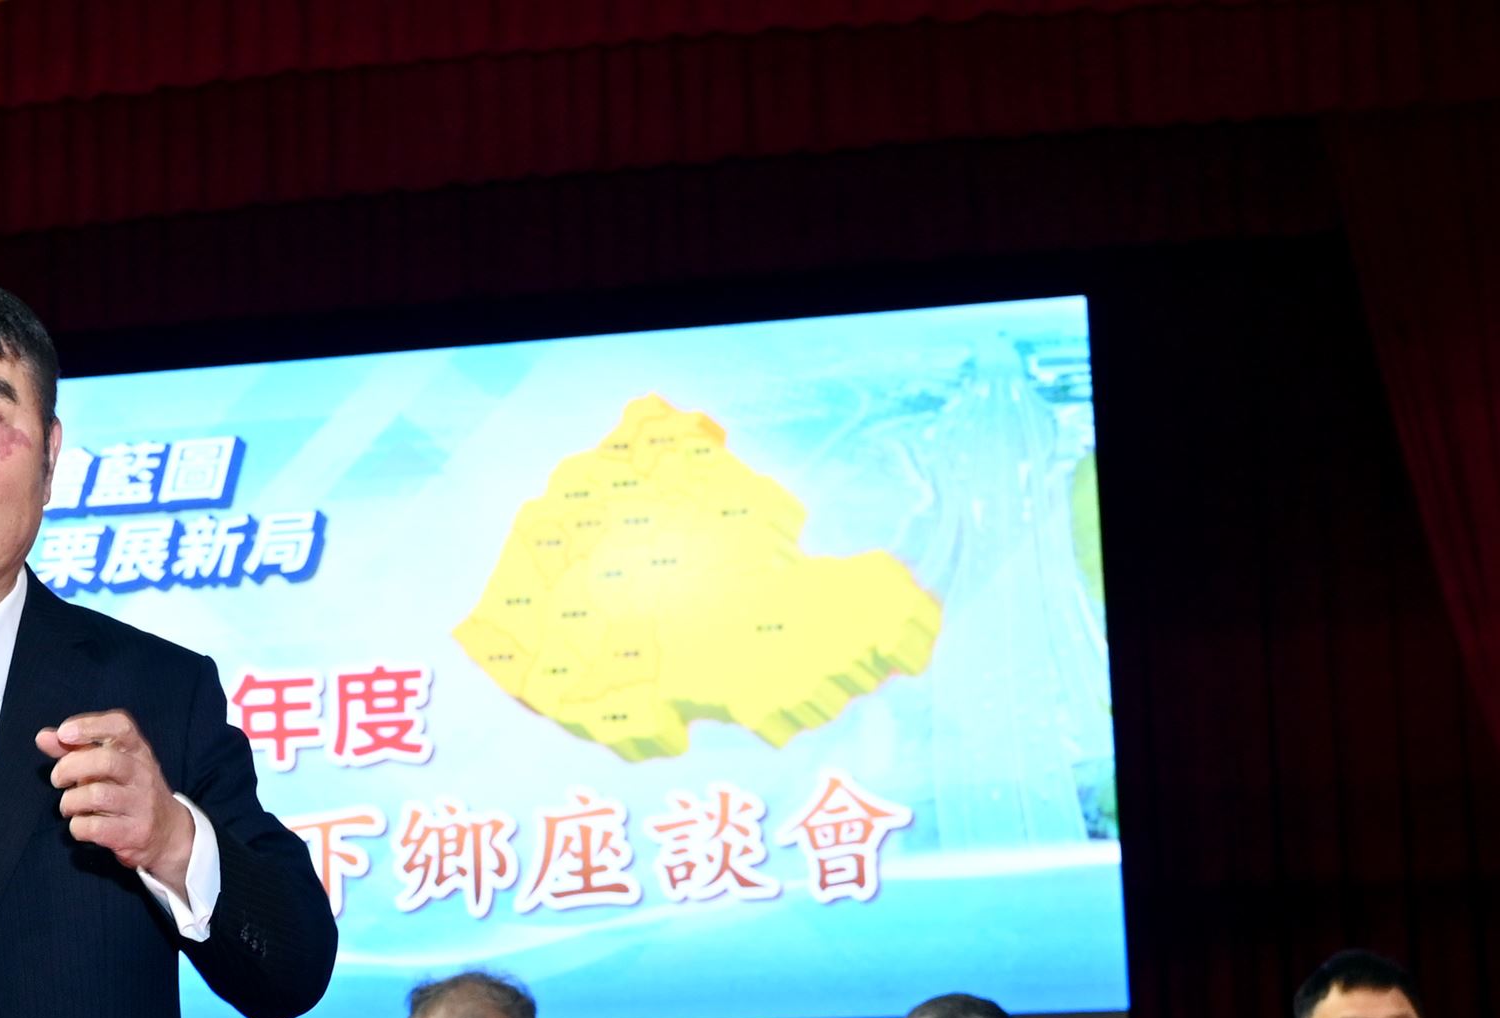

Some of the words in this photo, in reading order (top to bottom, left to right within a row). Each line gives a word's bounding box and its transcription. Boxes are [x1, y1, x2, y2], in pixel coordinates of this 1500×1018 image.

[36, 511, 317, 588] 栗展新局
[232, 665, 424, 762] 年度
[289, 777, 898, 906] 下鄉座談會
